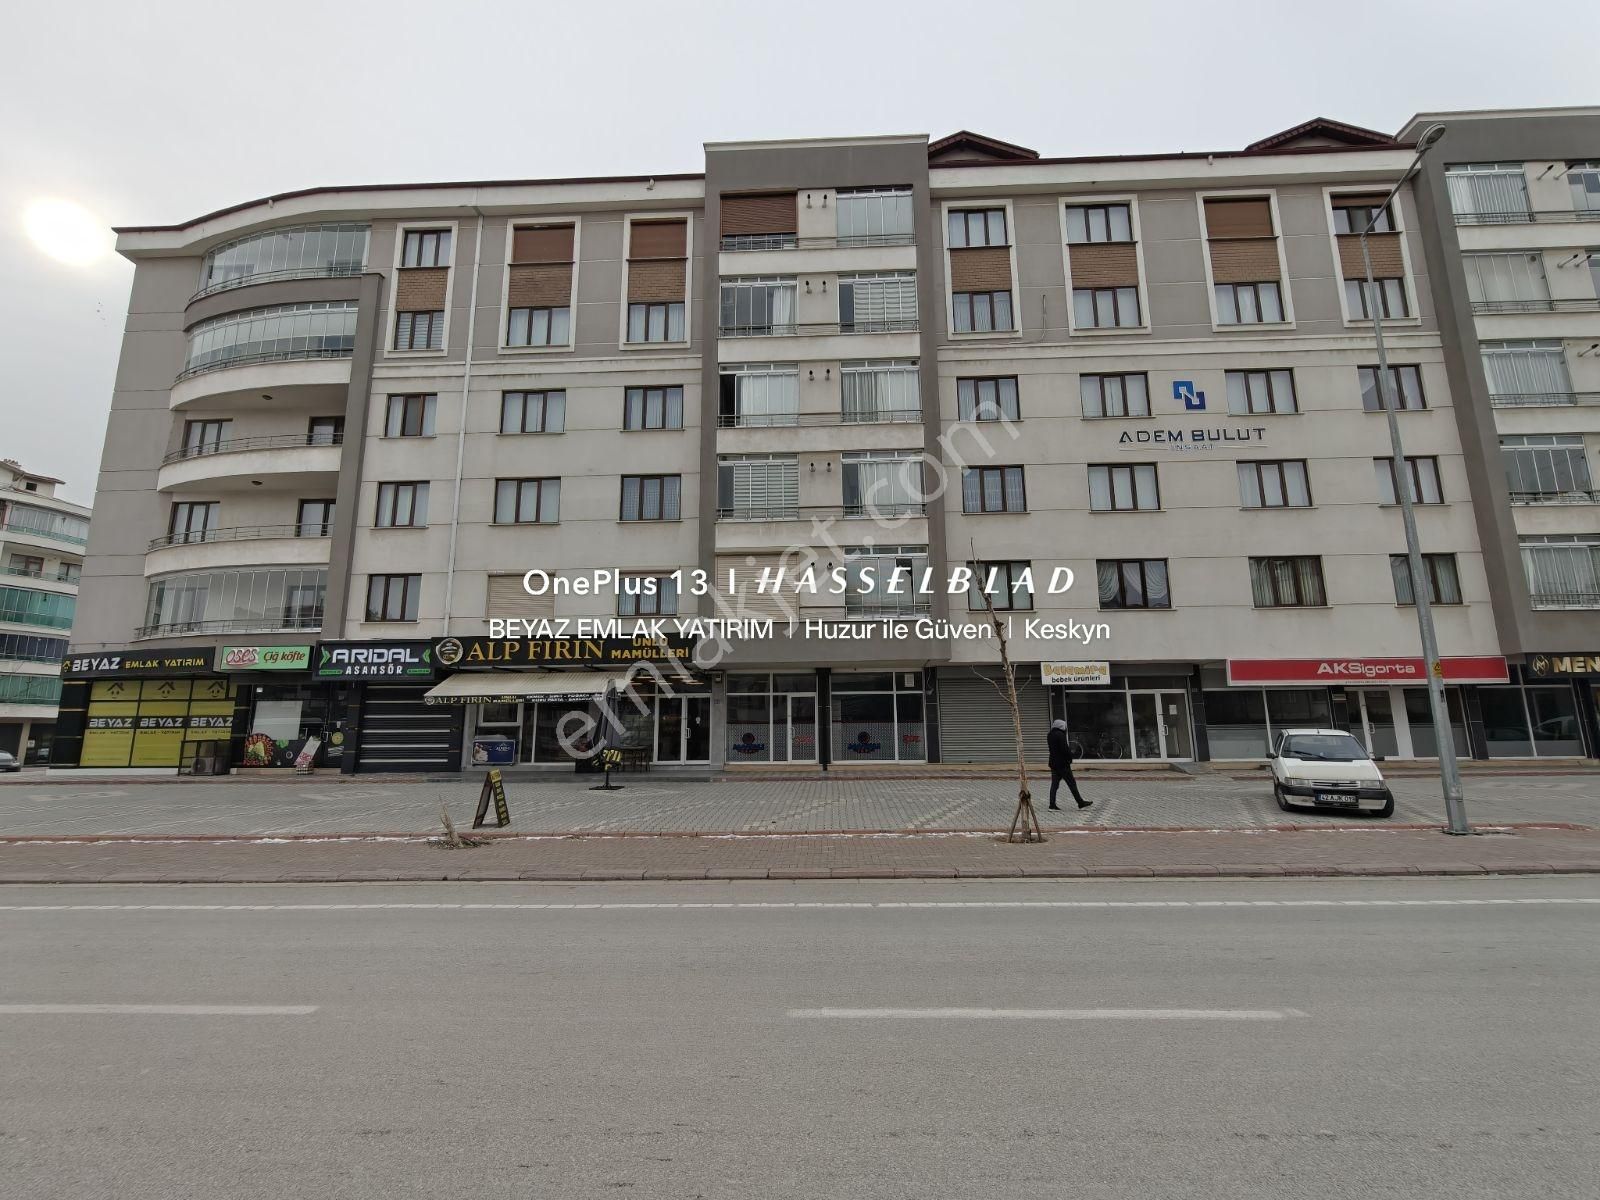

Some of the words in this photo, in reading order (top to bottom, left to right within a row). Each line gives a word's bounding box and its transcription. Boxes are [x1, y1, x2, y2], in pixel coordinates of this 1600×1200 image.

[1118, 429, 1184, 443] ADEM
[1191, 427, 1266, 442] BULUT
[466, 641, 520, 661] ALP
[528, 640, 604, 660] FIRIN
[281, 650, 306, 664] köfte
[72, 657, 121, 672] BEYAZ
[125, 659, 159, 669] EMLAK
[164, 658, 204, 667] YATIRIM
[345, 664, 403, 675] ASANSÖR
[1317, 662, 1416, 677] AKSigorta
[460, 696, 492, 704] FIRIN
[89, 718, 133, 728] BEYAZ
[139, 717, 184, 727] BEYAZ
[190, 716, 233, 727] BEYAZ
